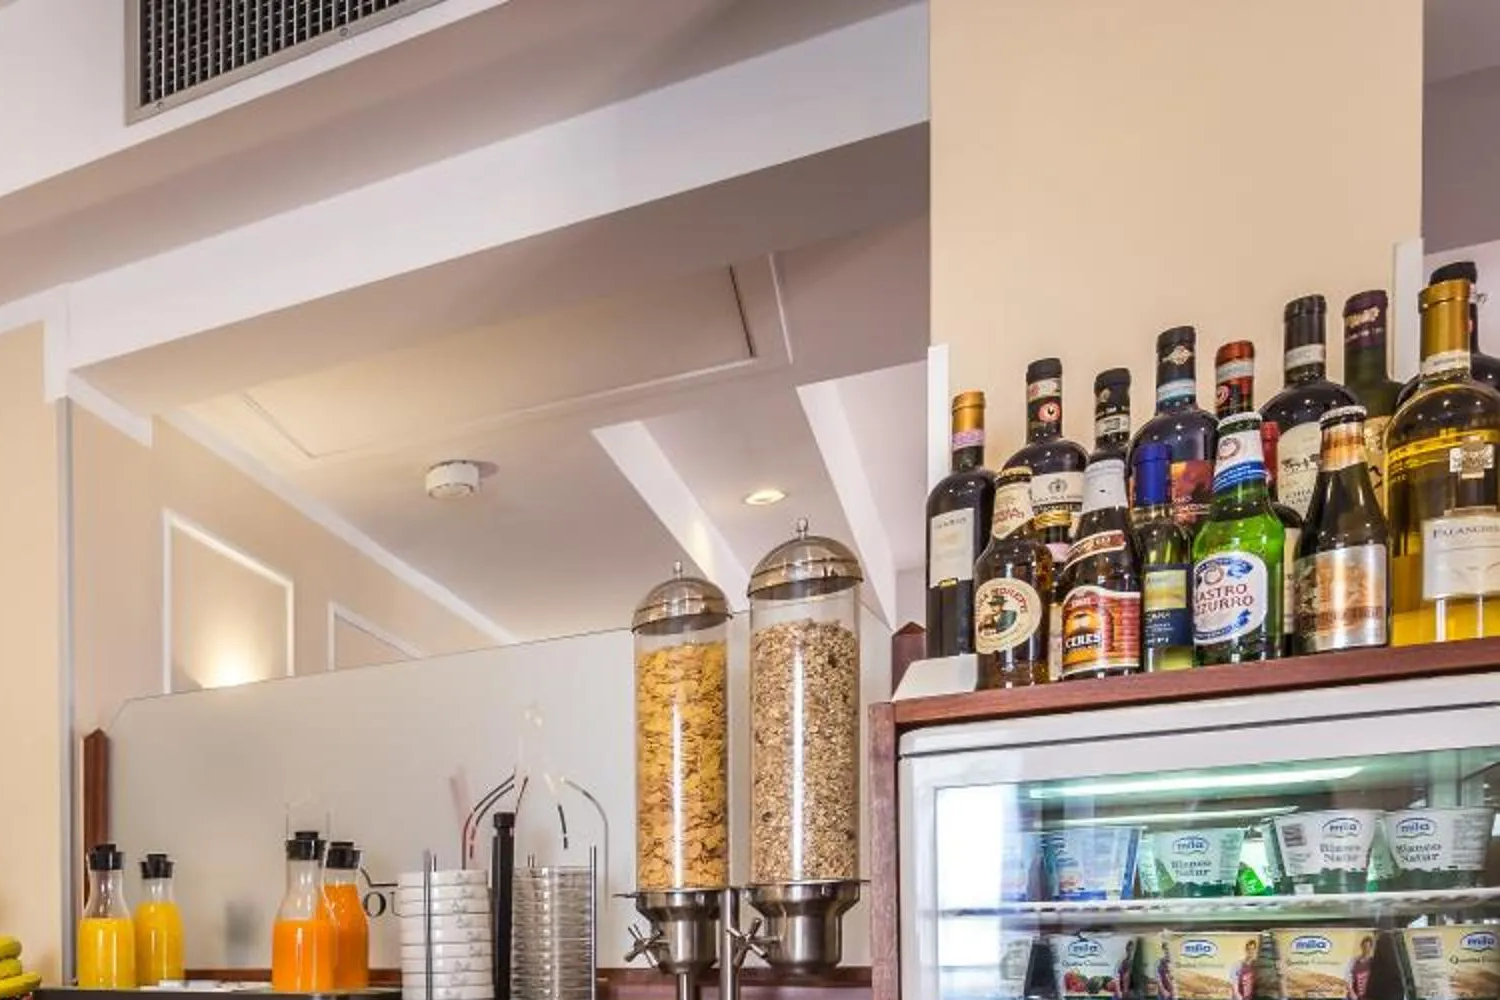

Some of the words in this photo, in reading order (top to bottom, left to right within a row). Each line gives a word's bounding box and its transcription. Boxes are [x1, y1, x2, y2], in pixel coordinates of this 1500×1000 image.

[1401, 821, 1431, 832] mila
[1184, 944, 1211, 953] mila
[1296, 939, 1326, 949] mila
